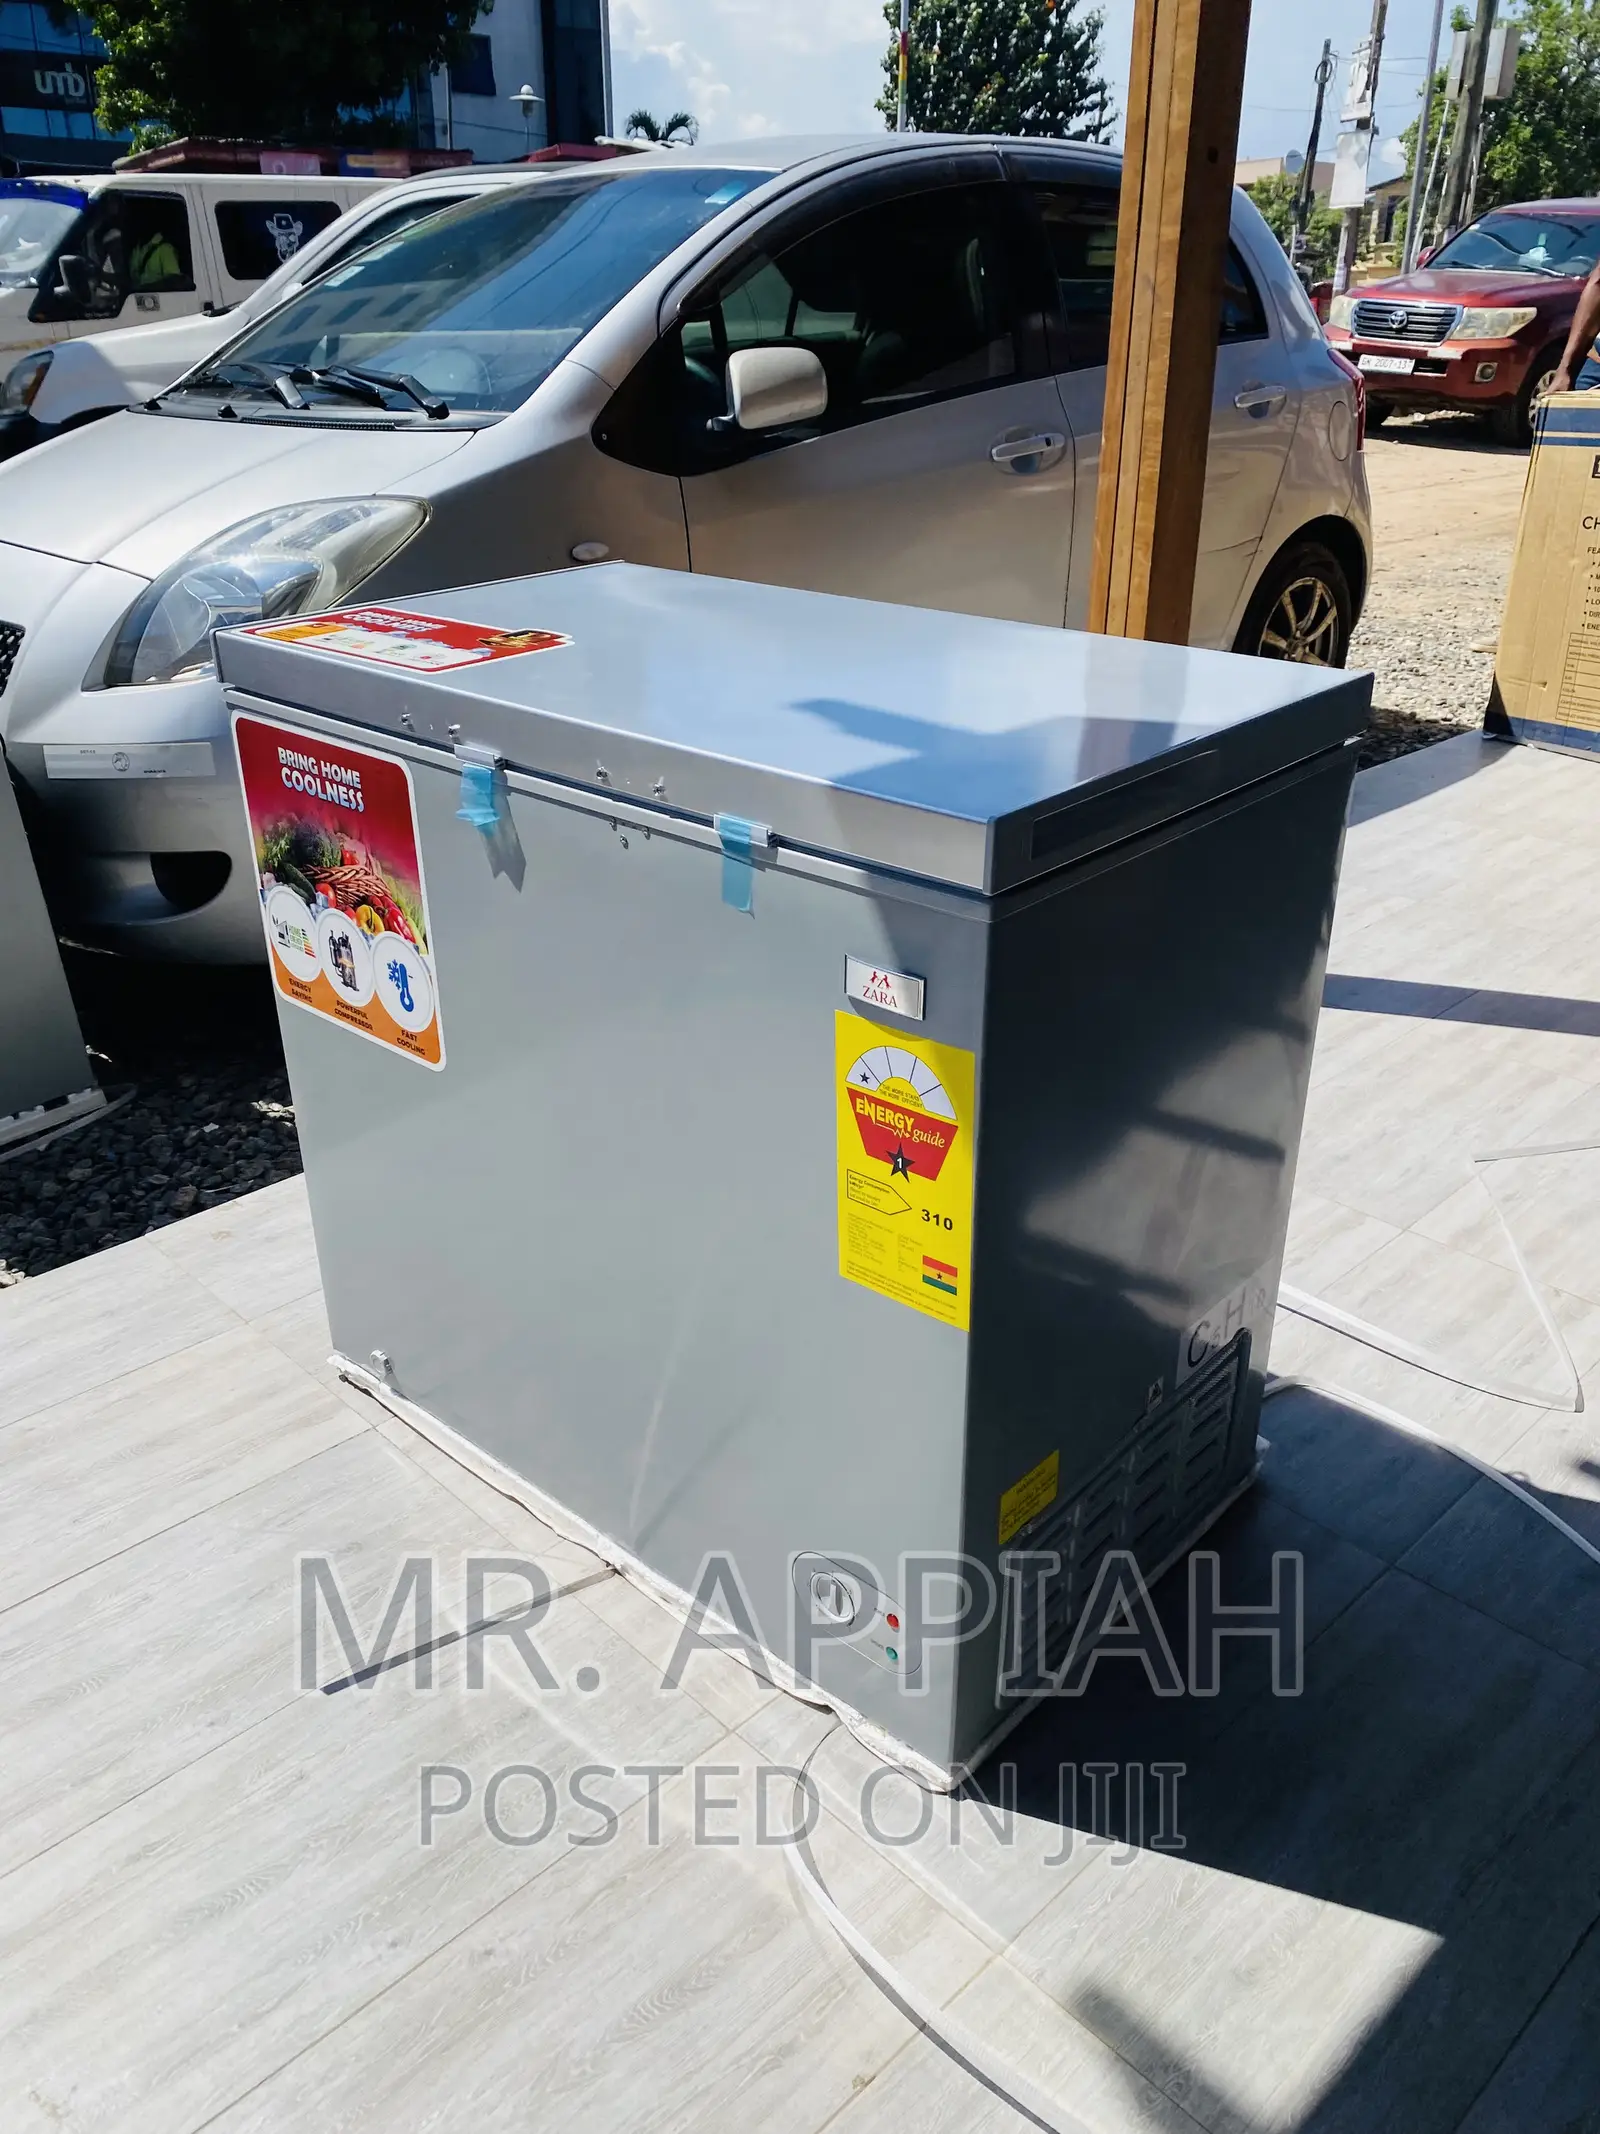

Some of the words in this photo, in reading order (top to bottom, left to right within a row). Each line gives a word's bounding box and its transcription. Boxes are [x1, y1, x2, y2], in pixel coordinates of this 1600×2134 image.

[277, 746, 319, 775] BRING
[320, 760, 361, 788] HOME
[281, 766, 365, 812] COOLNESS
[288, 978, 312, 993] ENERGY
[291, 988, 312, 1003] SAVING
[862, 985, 898, 1008] ZARA
[334, 1008, 374, 1031] COMPRESSOR
[336, 999, 368, 1020] POWERFUL
[396, 1037, 426, 1055] COOLING
[401, 1030, 418, 1042] FAST
[855, 1095, 915, 1132] ENERGY
[912, 1128, 945, 1148] guide
[896, 1156, 904, 1169] 1
[921, 1208, 953, 1231] 310
